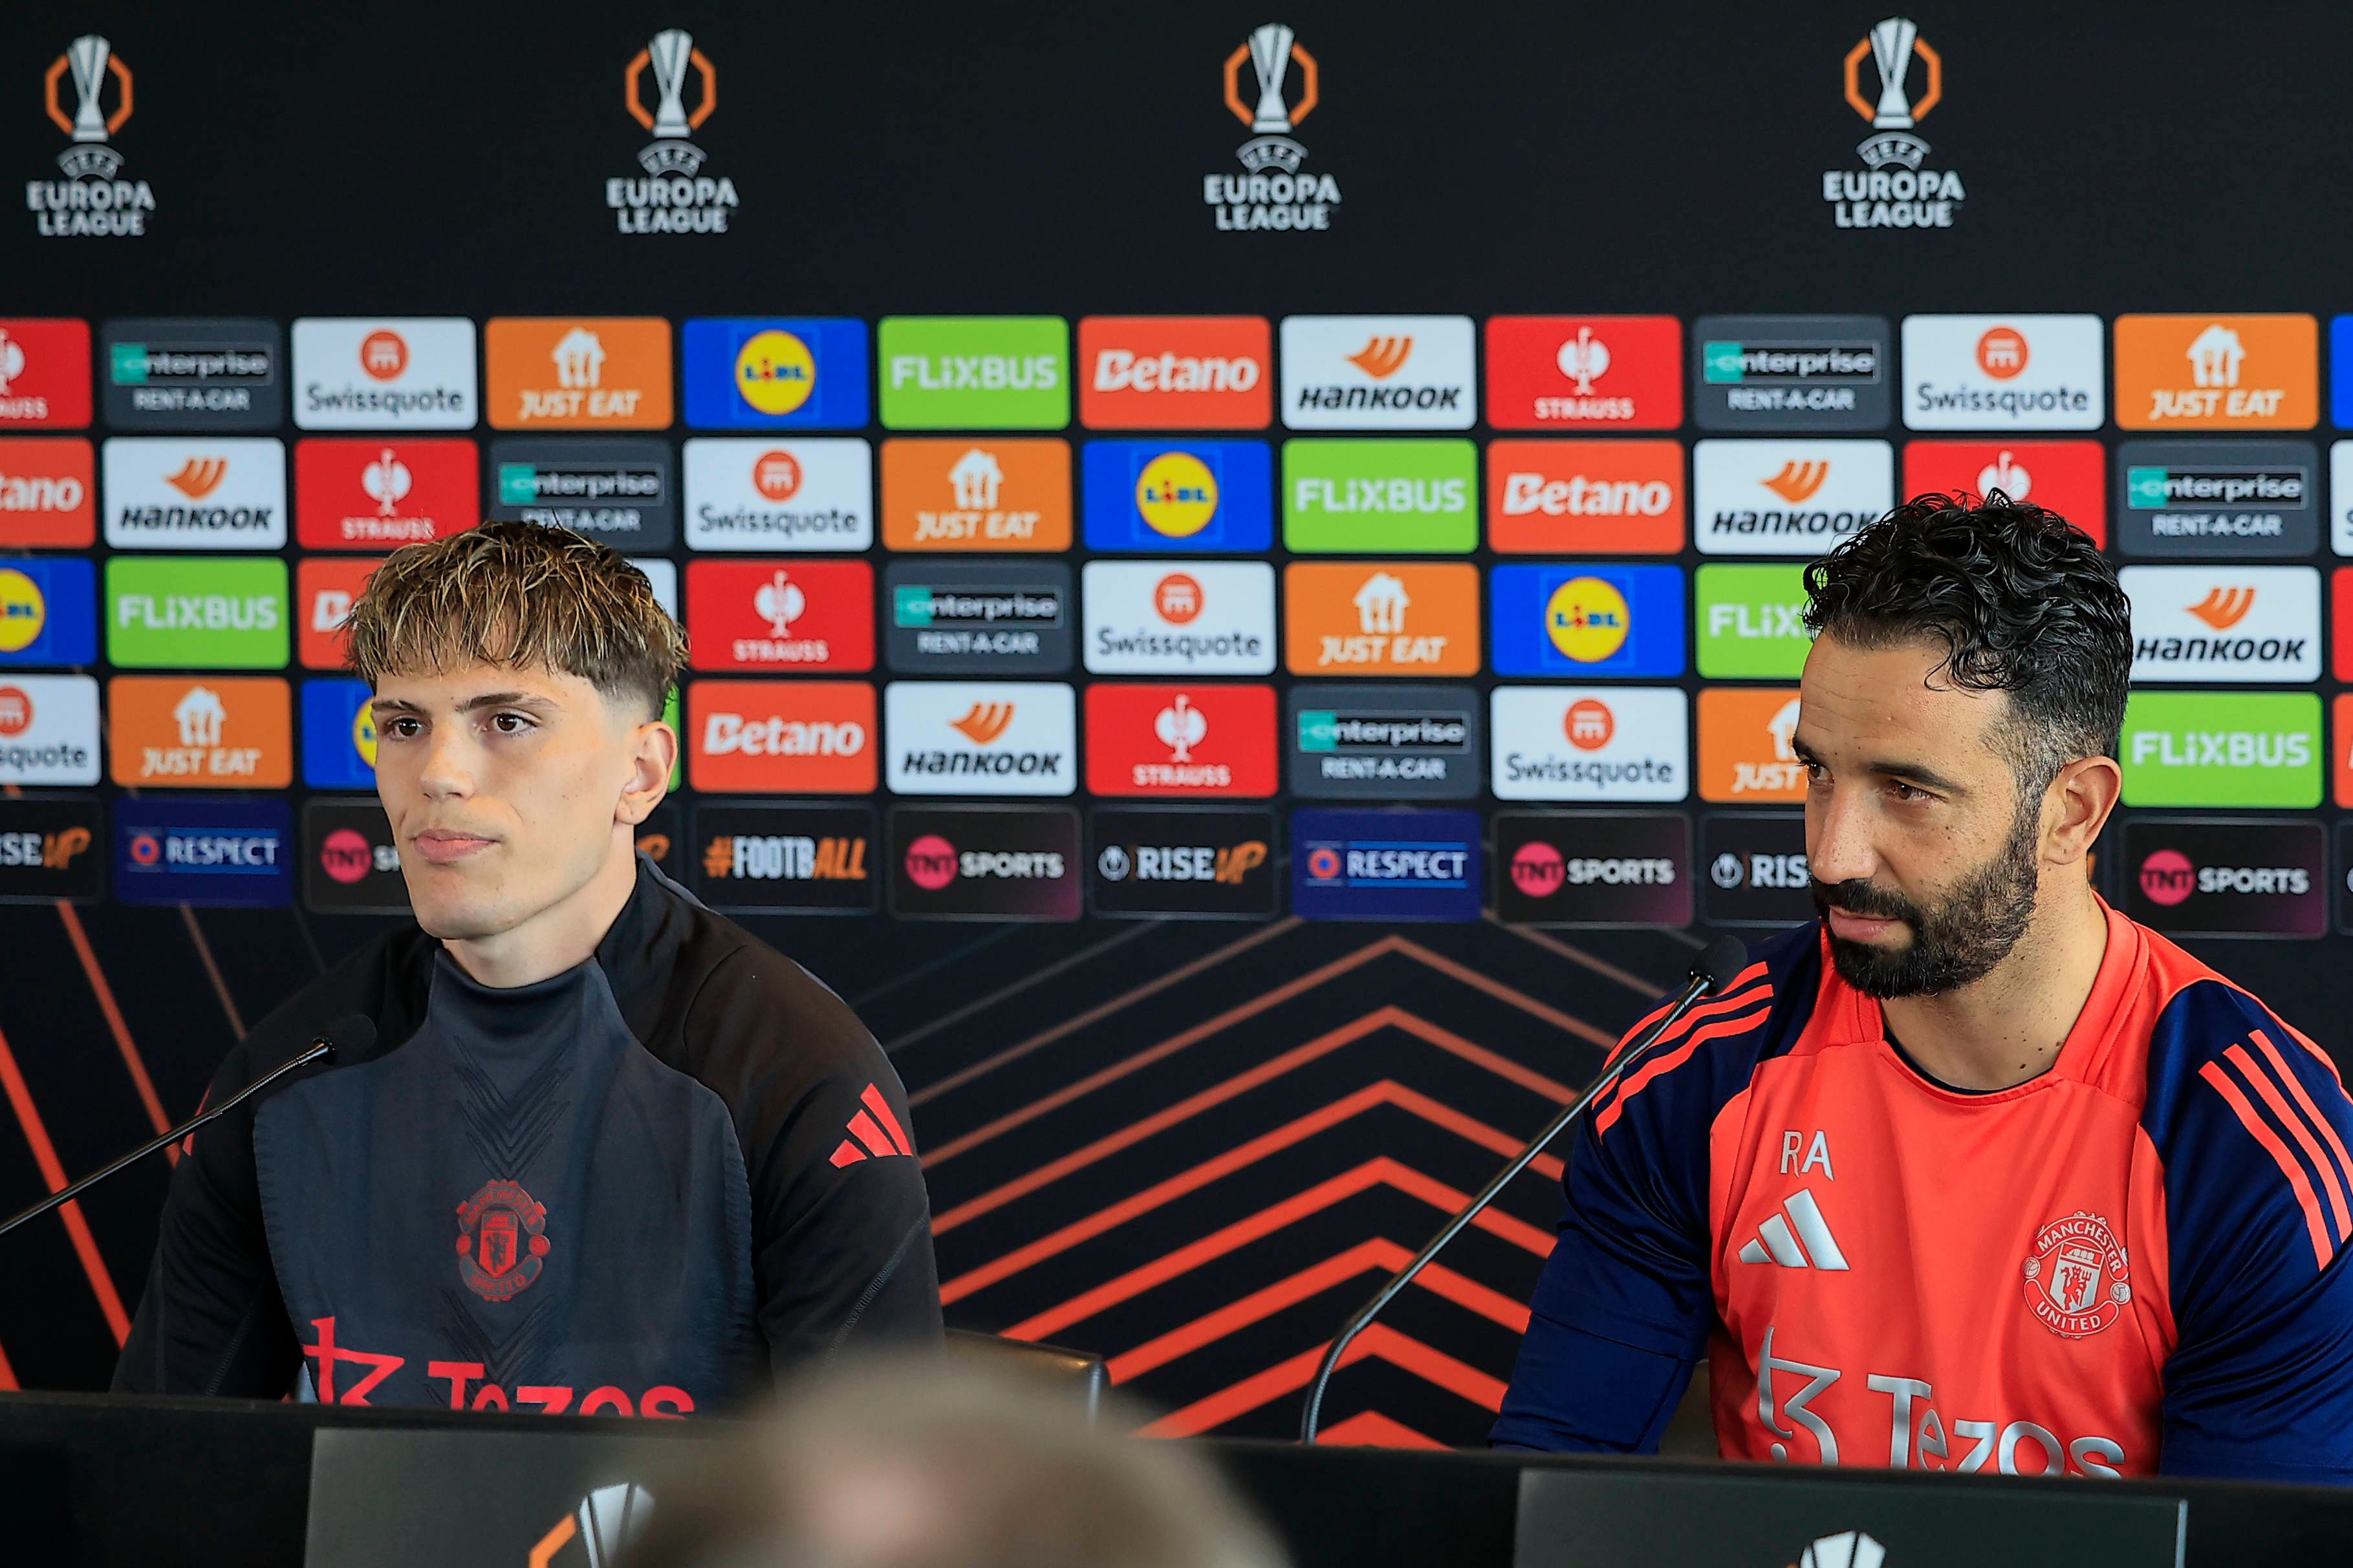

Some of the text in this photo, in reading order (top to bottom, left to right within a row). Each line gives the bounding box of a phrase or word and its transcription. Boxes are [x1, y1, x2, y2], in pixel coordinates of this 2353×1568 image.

[1859, 140, 1925, 166] UEFA
[27, 180, 156, 211] EUROPA
[606, 177, 739, 208] EUROPA
[1203, 173, 1341, 205] EUROPA
[1823, 170, 1966, 201] EUROPA
[38, 211, 146, 237] LEAGUE
[618, 208, 728, 234] LEAGUE
[1216, 204, 1330, 231] LEAGUE
[1834, 200, 1954, 228] LEAGUE
[124, 351, 269, 378] enterprise
[1093, 349, 1260, 392] Betano
[1717, 348, 1874, 380] enterprise
[0, 397, 49, 420] AUSS
[306, 381, 464, 418] Swissquote
[518, 389, 642, 420] JUST EAT
[1534, 397, 1636, 420] STRAUSS
[1916, 382, 2088, 419] Swissquote
[2148, 389, 2286, 420] JUST EAT
[511, 471, 660, 500] enterprise
[1501, 472, 1673, 516] Betano
[2141, 473, 2302, 504] enterprise
[340, 517, 437, 540] STRAUSS
[698, 504, 858, 542] Swissquote
[913, 511, 1041, 542] JUST EAT
[907, 592, 1059, 623] enterprise
[732, 639, 830, 663] STRAUSS
[1098, 627, 1263, 662] Swissquote
[1318, 636, 1449, 666] JUST EAT
[702, 712, 866, 757] Betano
[1309, 718, 1466, 747] enterprise
[141, 747, 263, 777] JUST EAT
[1131, 764, 1232, 788] STRAUSS
[1505, 753, 1673, 789] Swissquote
[1730, 762, 1805, 794] JUST
[0, 832, 43, 867] SE
[166, 836, 280, 866] RESPECT
[325, 848, 371, 866] TNT
[703, 835, 867, 880] #FOOTBALL
[909, 851, 1065, 879] TNT SPORTS
[1135, 846, 1216, 881] RISE
[1347, 850, 1468, 879] RESPECT
[1513, 857, 1676, 885] TNT SPORTS
[1750, 853, 1810, 888] RIS
[2143, 866, 2311, 896] TNT SPORTS
[1779, 1130, 1835, 1182] RA
[2037, 1221, 2122, 1274] MANCHESTER
[2037, 1300, 2101, 1331] UNITED
[1867, 1373, 2127, 1479] Tezos
